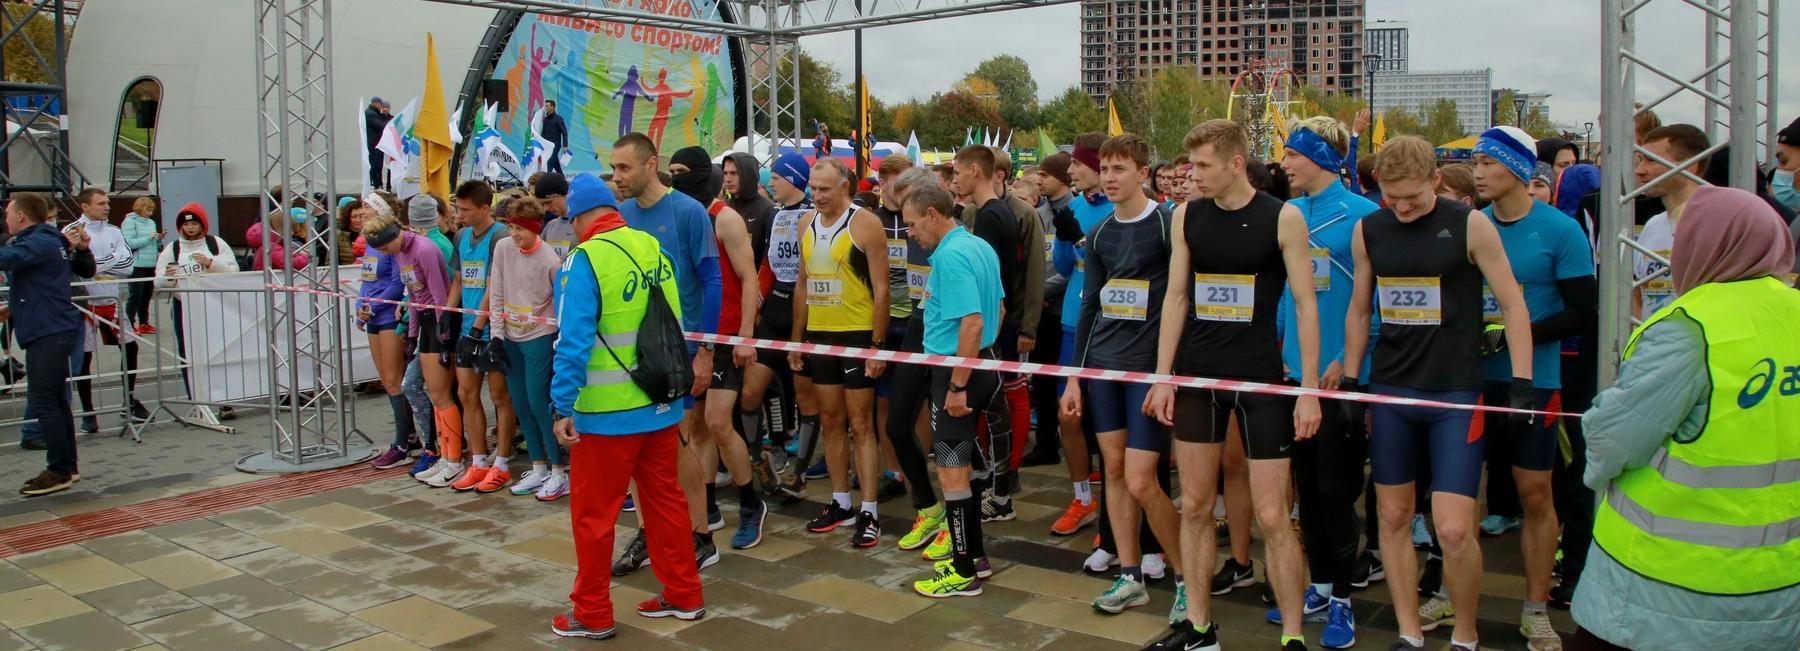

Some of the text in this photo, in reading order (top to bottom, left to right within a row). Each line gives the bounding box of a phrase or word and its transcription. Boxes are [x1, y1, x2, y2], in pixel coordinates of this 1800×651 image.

[777, 241, 799, 258] 594
[465, 268, 478, 278] 597
[814, 281, 830, 293] 131
[1207, 286, 1238, 303] 231
[1108, 289, 1137, 304] 238
[1390, 290, 1428, 306] 232
